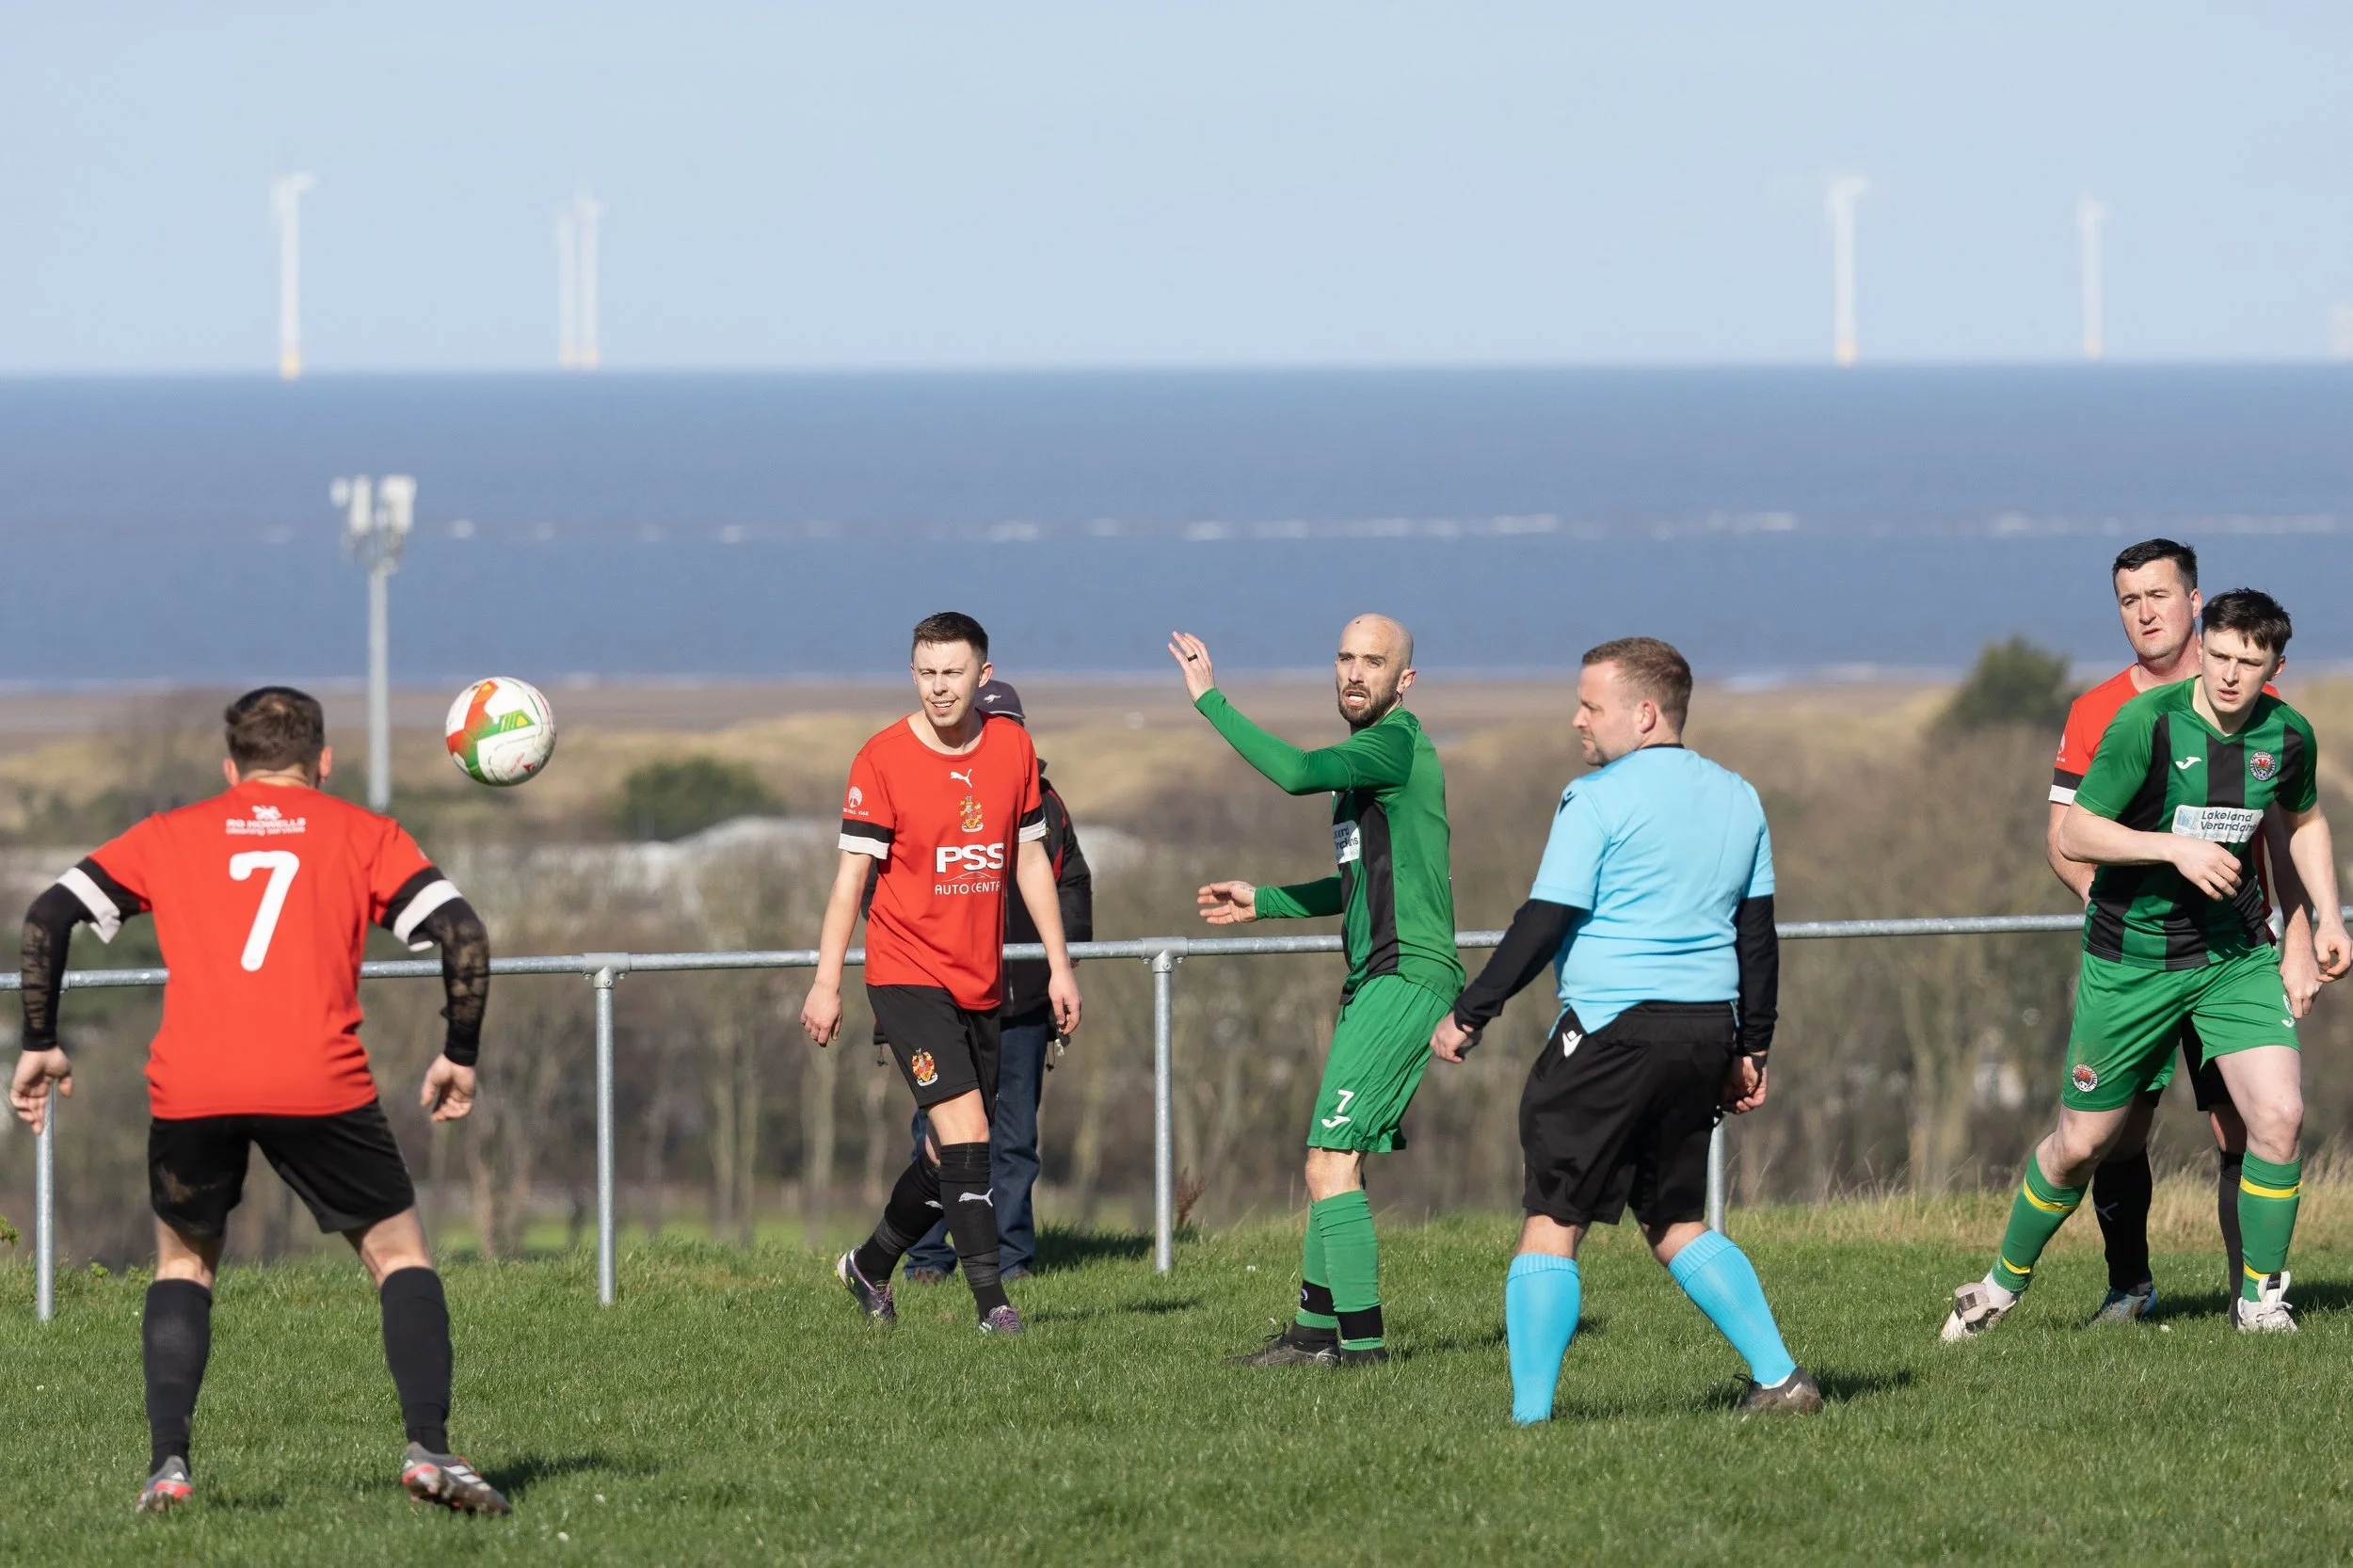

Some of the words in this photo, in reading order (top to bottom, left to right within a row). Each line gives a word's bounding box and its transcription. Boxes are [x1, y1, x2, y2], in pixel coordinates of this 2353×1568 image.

[2201, 810, 2253, 822] Lakeland
[2201, 821, 2257, 832] Verandahs
[936, 842, 1004, 873] PSS
[971, 881, 1001, 893] CENTR
[230, 850, 300, 972] 7
[1337, 1089, 1355, 1113] 7
